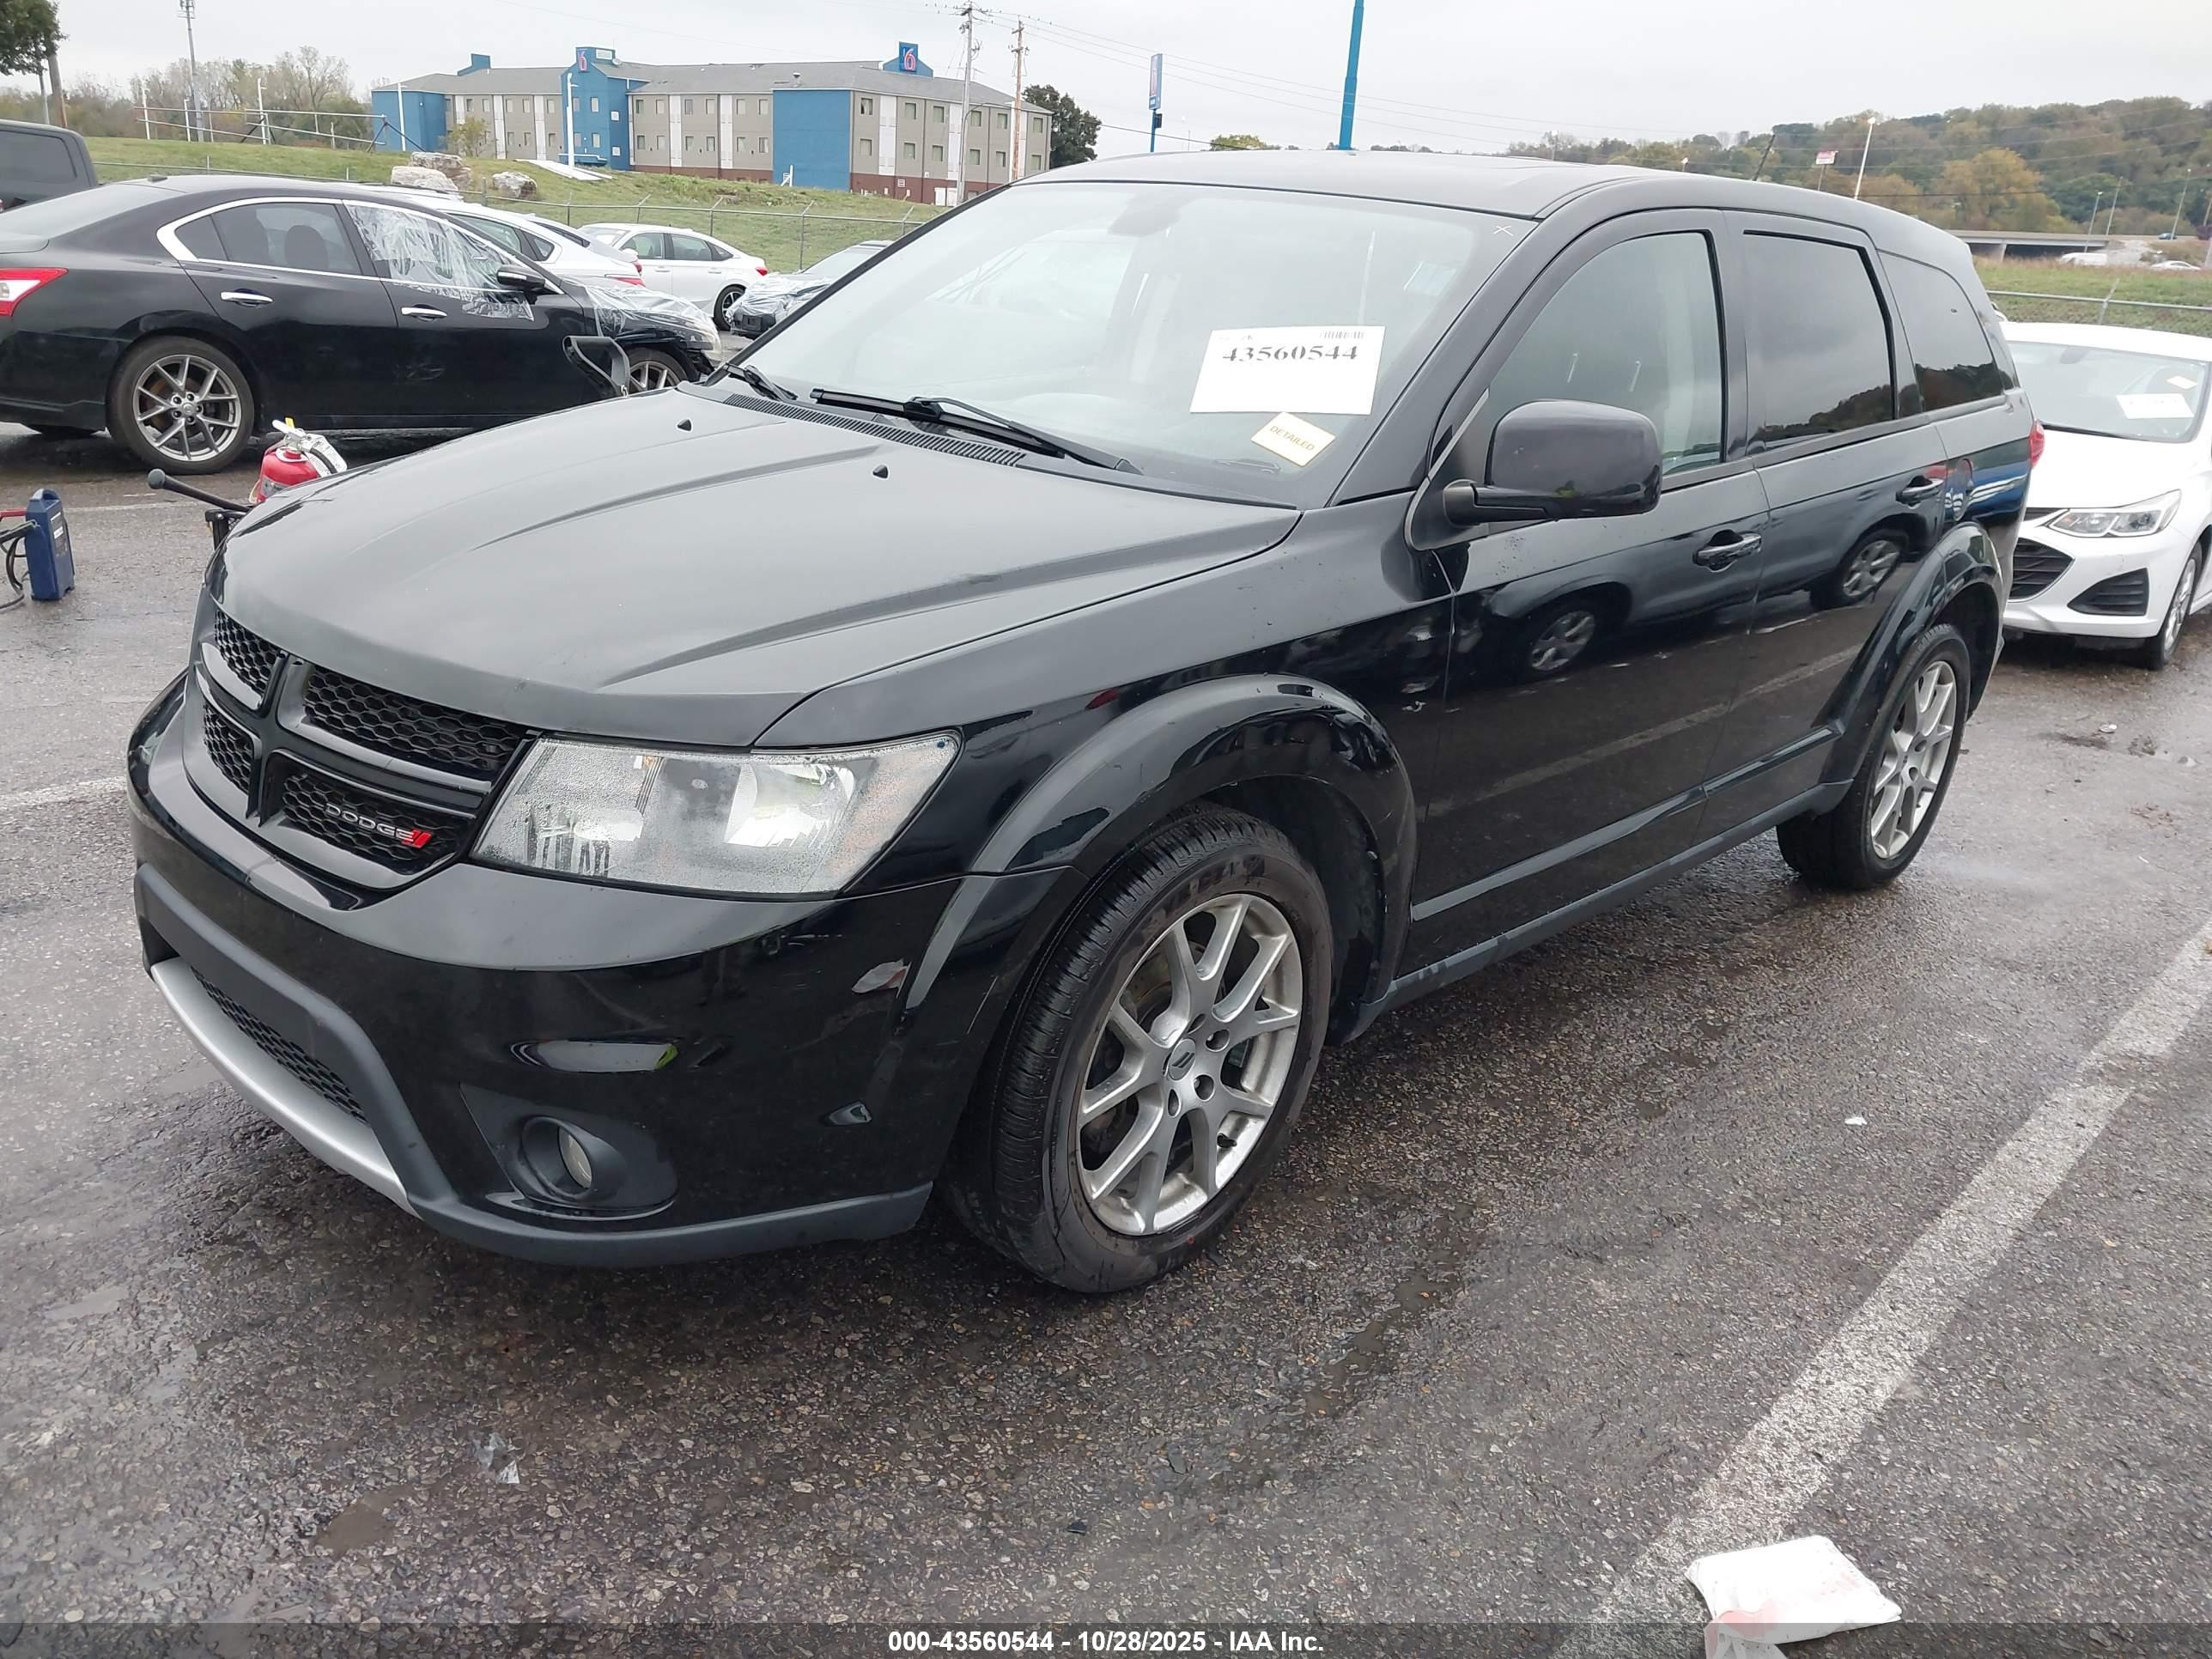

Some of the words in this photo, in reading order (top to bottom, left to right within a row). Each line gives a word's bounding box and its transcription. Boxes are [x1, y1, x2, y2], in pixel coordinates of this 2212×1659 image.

[903, 47, 916, 71] 6
[1222, 345, 1358, 362] 43560544
[1269, 424, 1316, 452] DETAILED
[325, 803, 415, 842] DODGE
